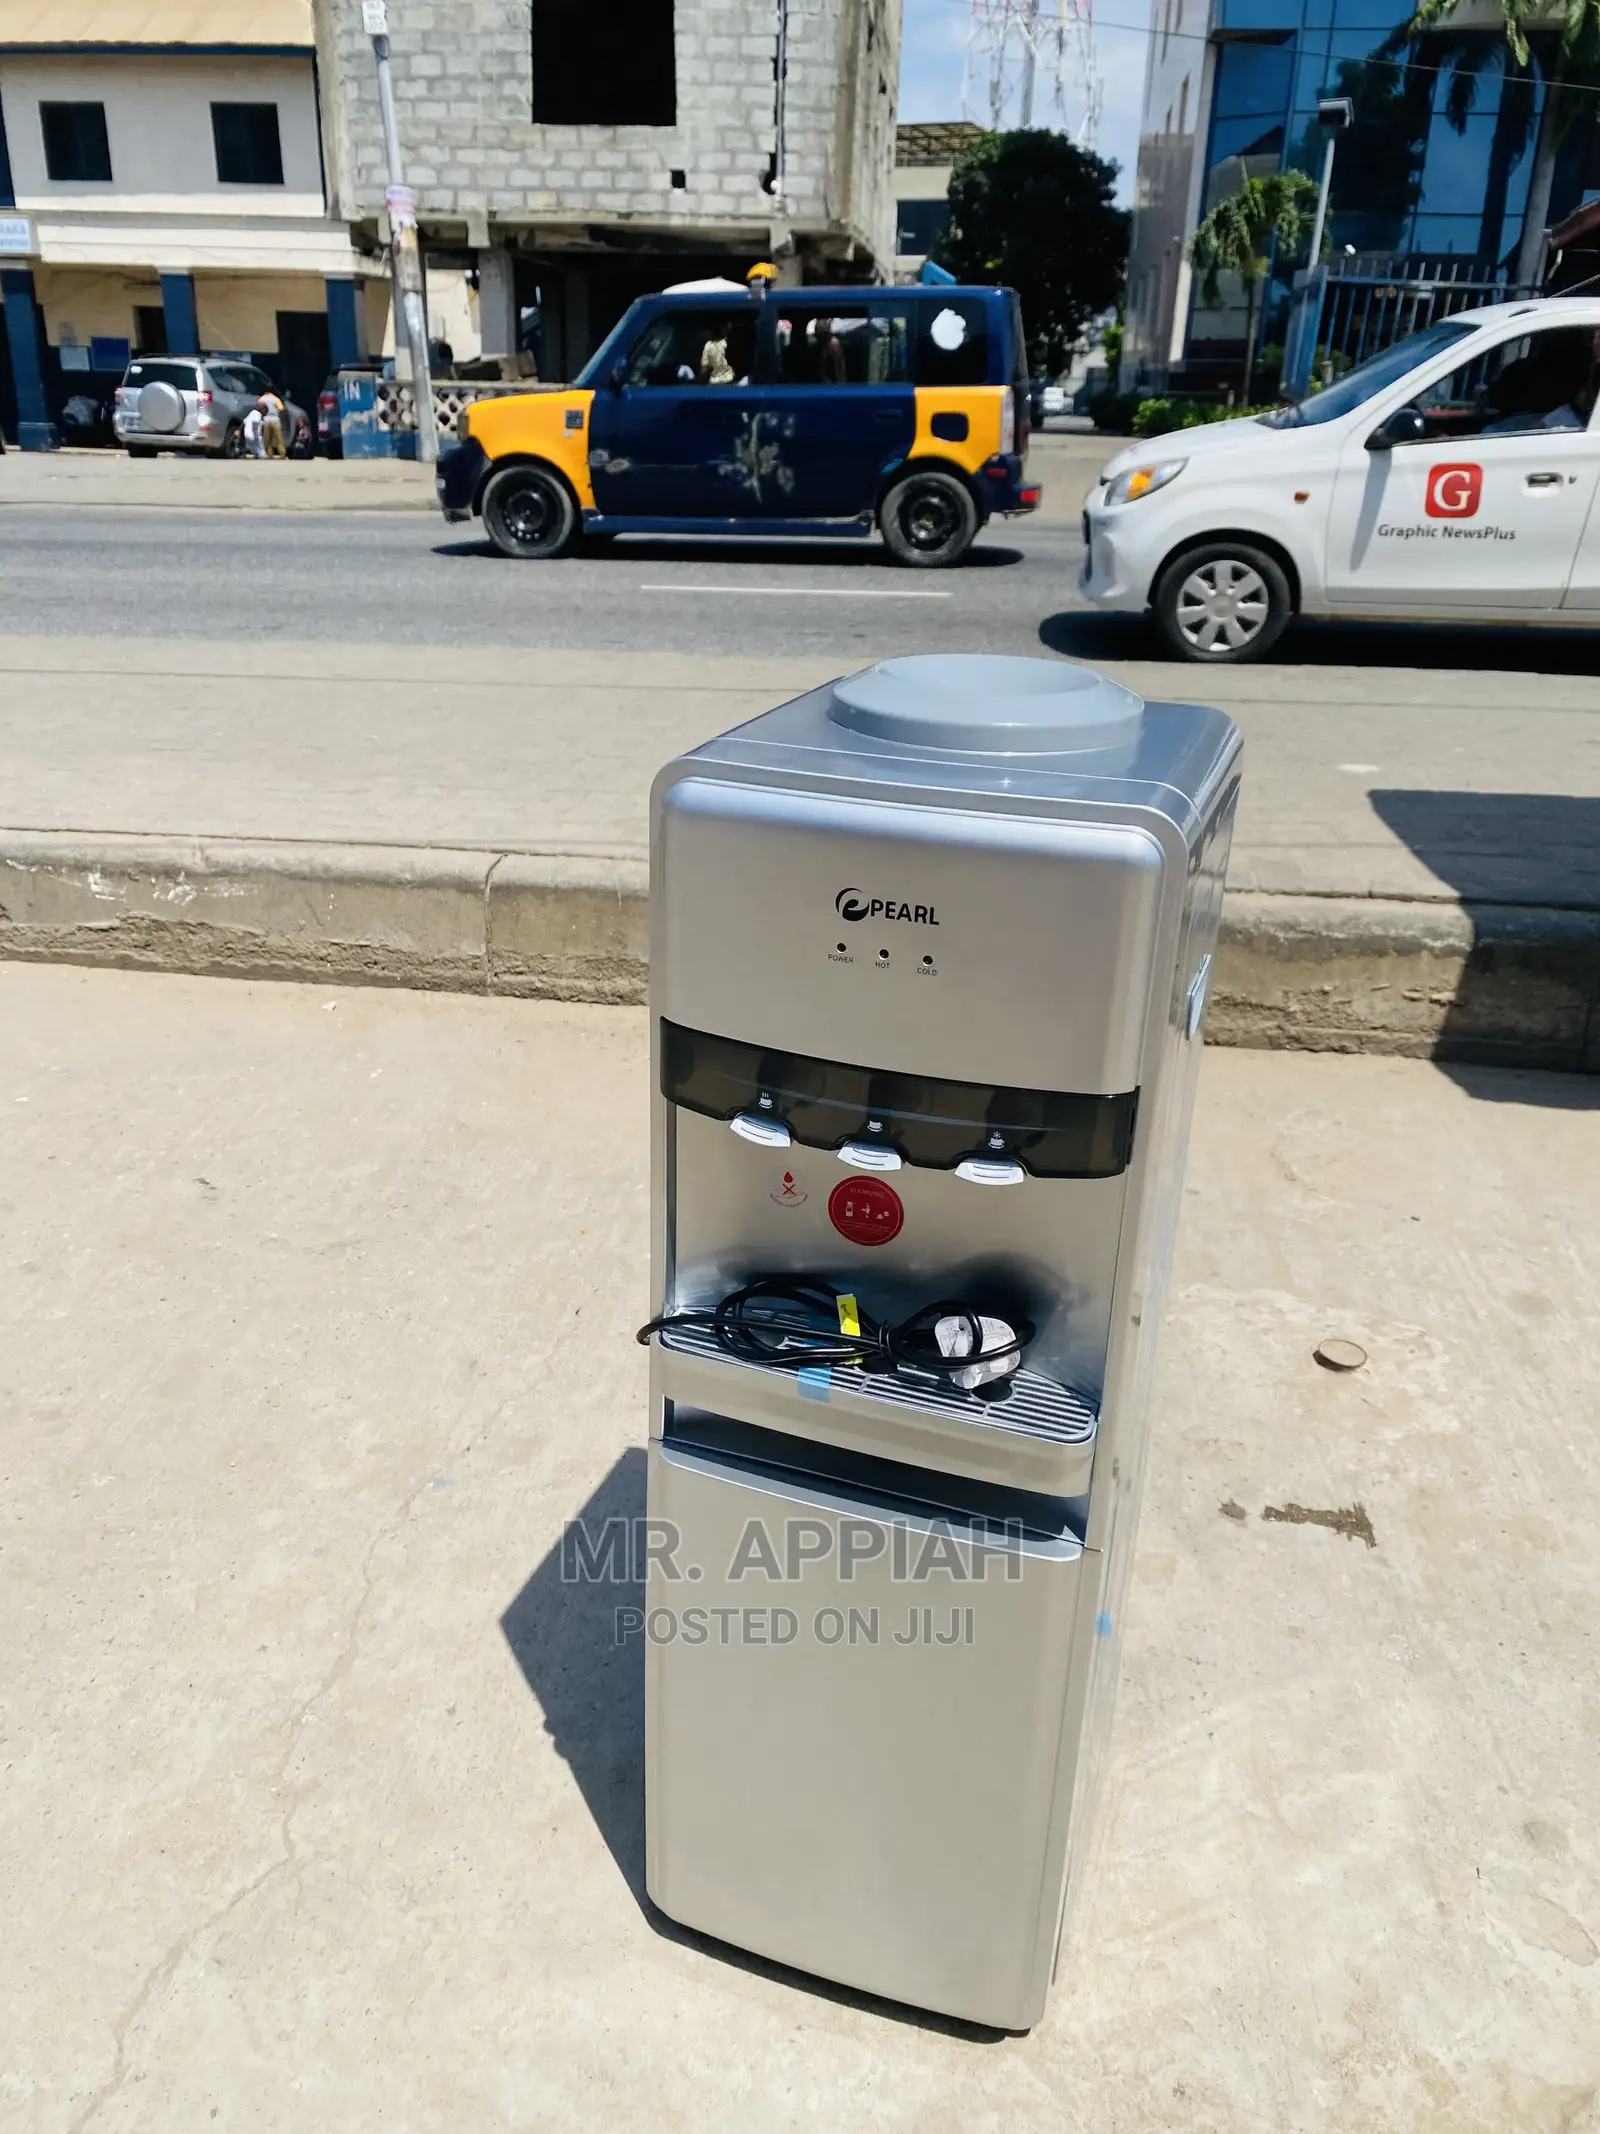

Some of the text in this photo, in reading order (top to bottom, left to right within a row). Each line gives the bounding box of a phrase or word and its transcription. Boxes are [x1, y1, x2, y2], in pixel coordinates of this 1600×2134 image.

[344, 380, 361, 401] IN
[1433, 470, 1472, 511] G
[1377, 524, 1517, 541] Graphic NewsPlus
[870, 898, 940, 926] PEARL
[827, 953, 854, 964] POWER
[875, 961, 890, 969] HOT
[916, 967, 938, 976] COLD
